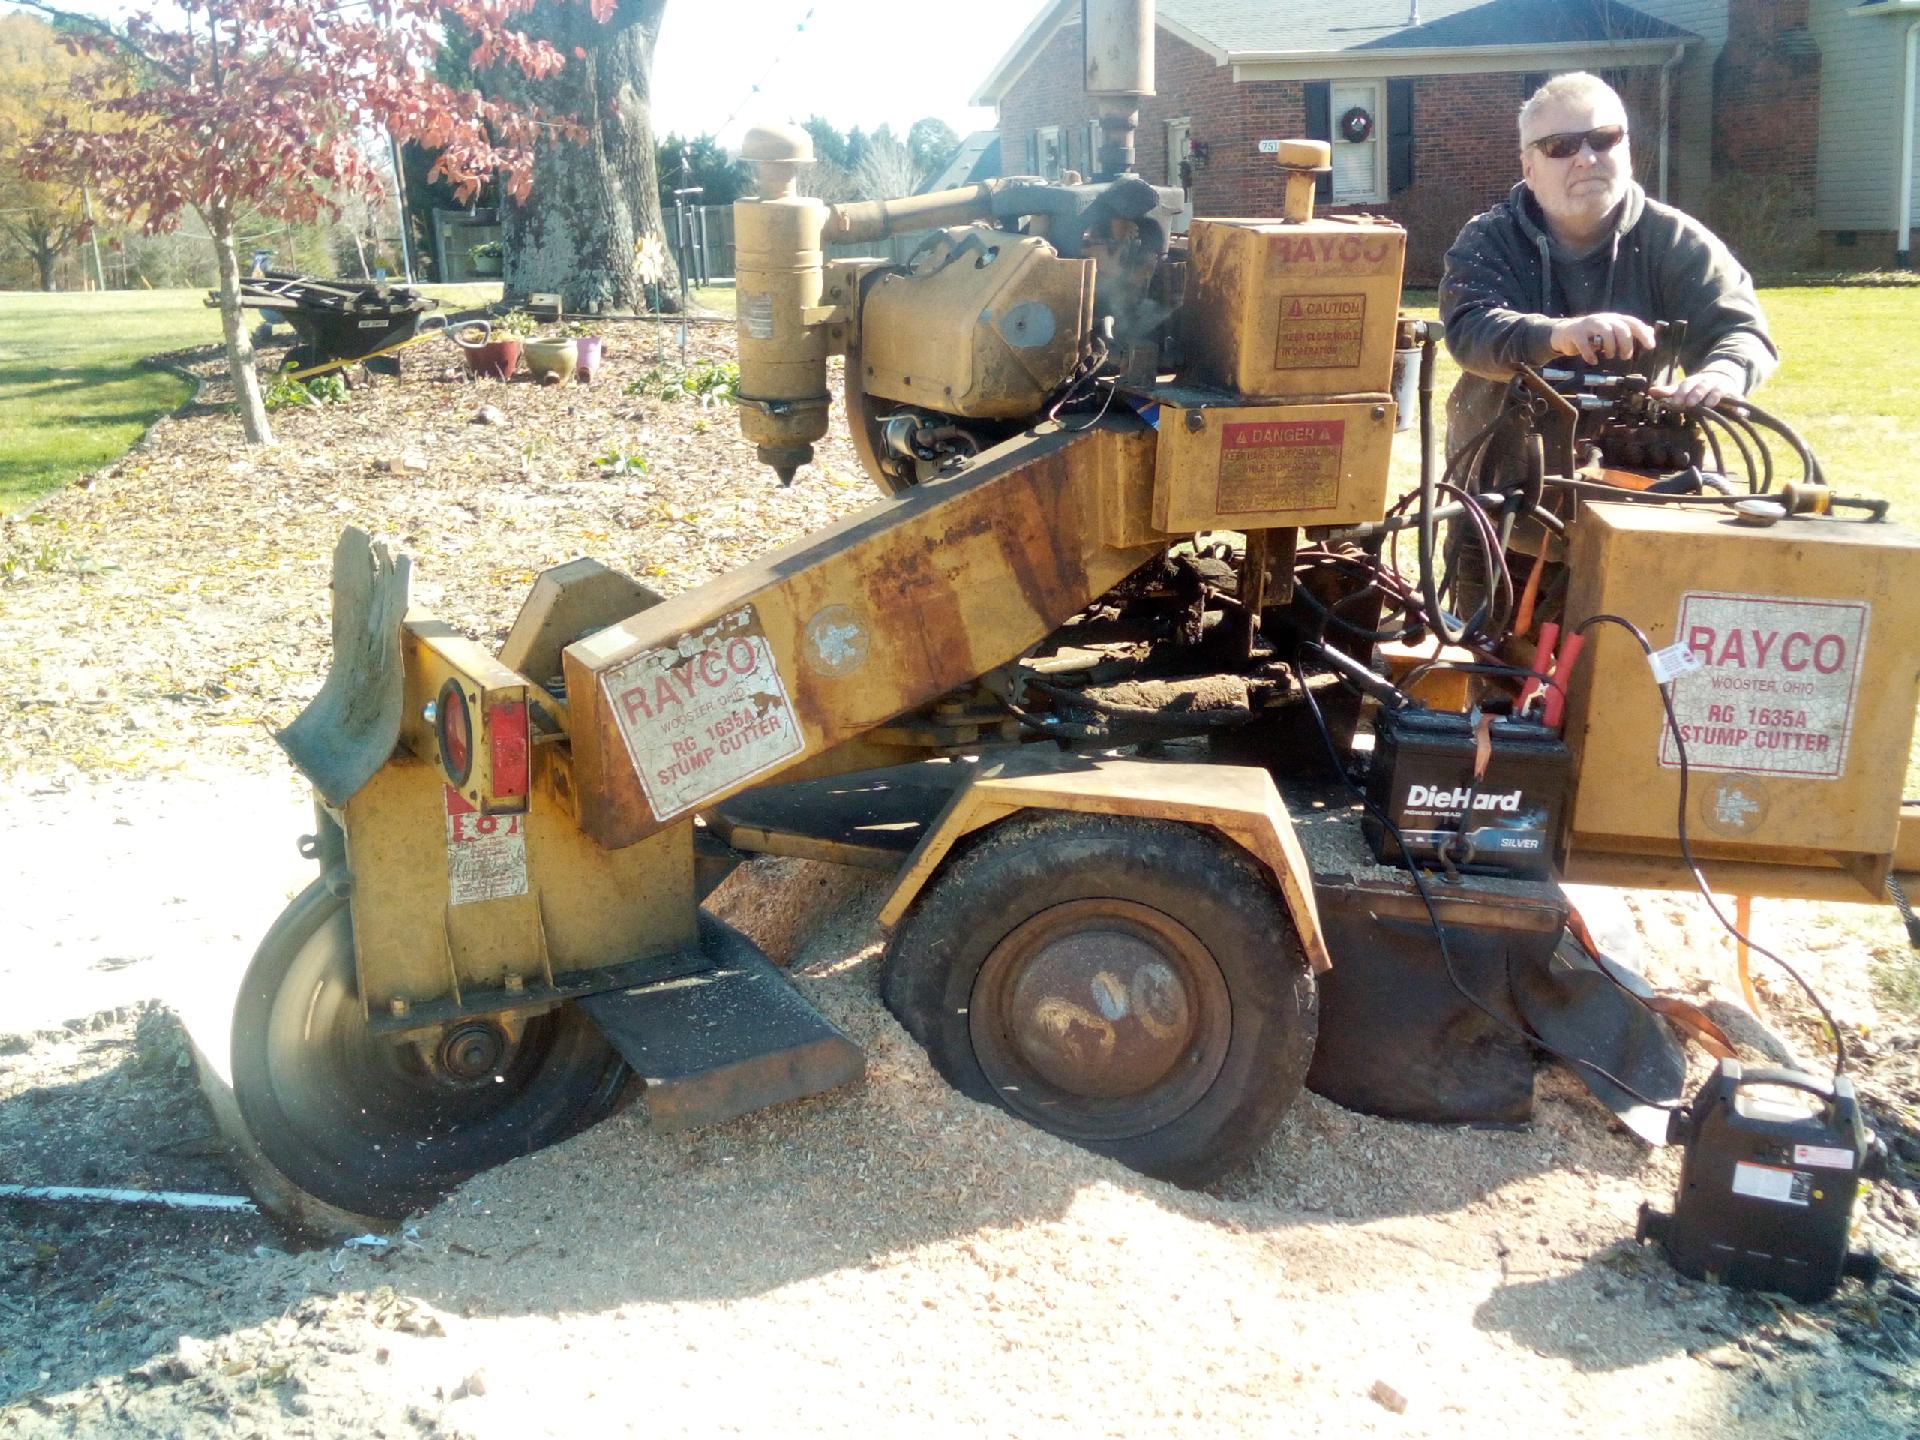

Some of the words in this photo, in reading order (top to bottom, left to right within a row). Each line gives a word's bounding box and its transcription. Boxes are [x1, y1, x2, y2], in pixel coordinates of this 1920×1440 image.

[1306, 302, 1361, 315] CAUTION
[1252, 428, 1315, 442] DANGER
[1688, 625, 1846, 674] RAYCO
[621, 637, 756, 726] RAYCO
[1712, 677, 1778, 694] WOOSTER,
[1783, 681, 1815, 695] OHIO
[719, 686, 745, 706] OHIO
[1707, 704, 1735, 723] RG
[1749, 707, 1807, 728] 1635A
[671, 736, 698, 758] RG
[705, 706, 755, 740] 1635A
[1680, 725, 1748, 747] STUMP
[1755, 730, 1830, 751] CUTTER
[657, 747, 716, 785] STUMP
[719, 714, 782, 756] CUTTER
[1407, 784, 1522, 811] DieHard
[1501, 837, 1540, 849] SILVER
